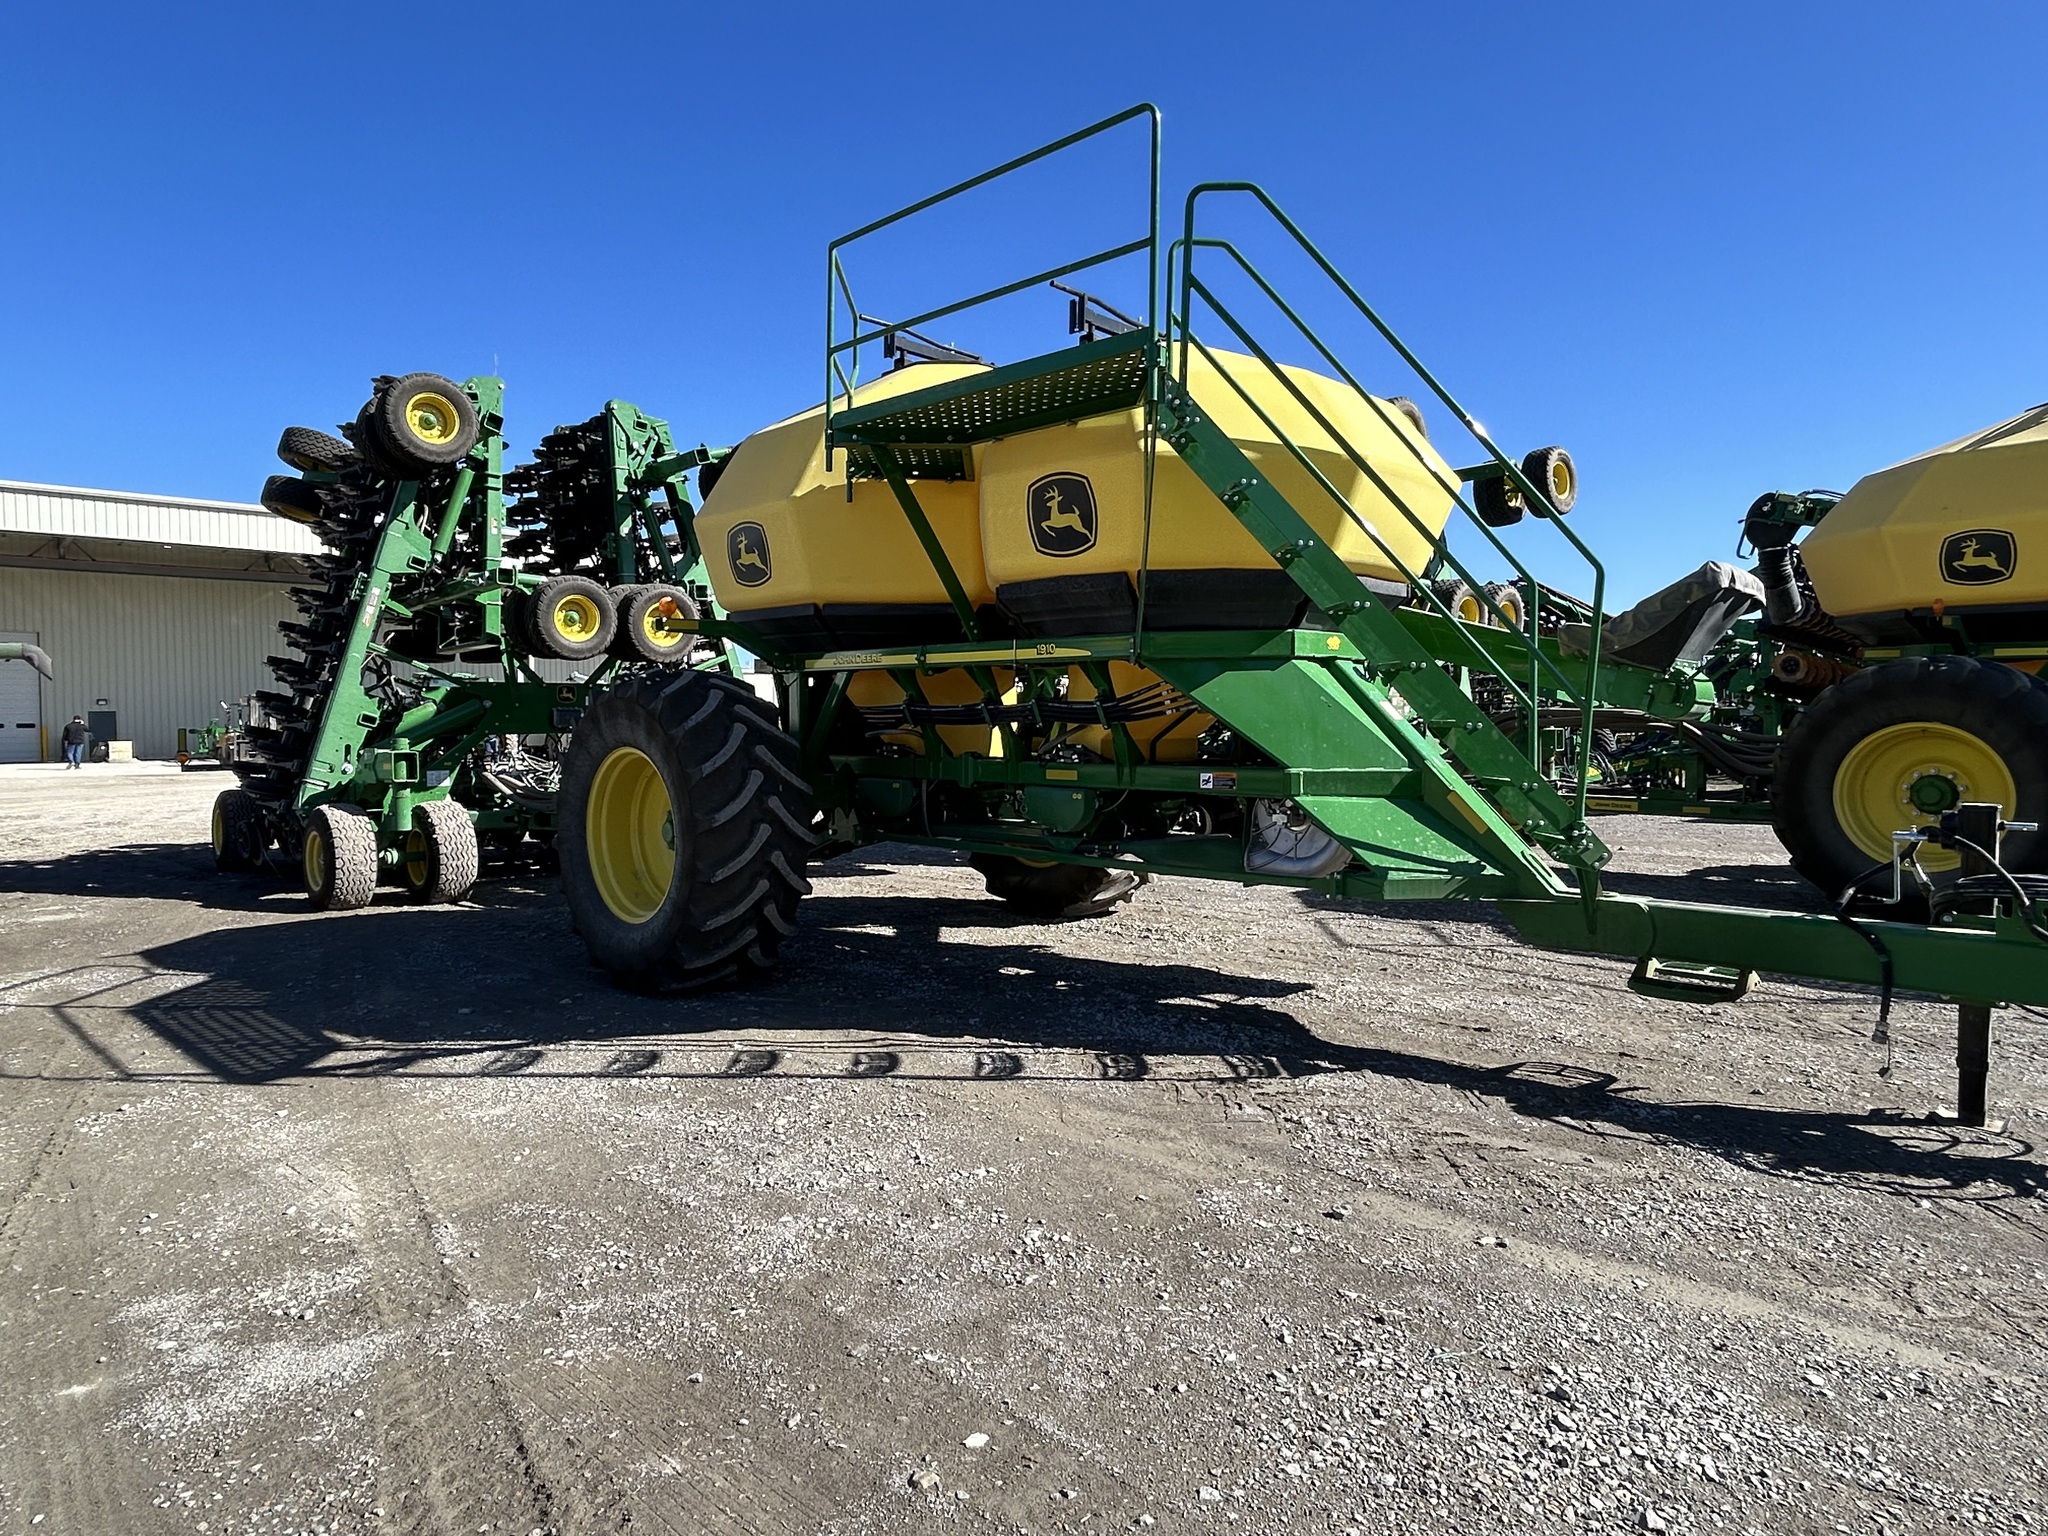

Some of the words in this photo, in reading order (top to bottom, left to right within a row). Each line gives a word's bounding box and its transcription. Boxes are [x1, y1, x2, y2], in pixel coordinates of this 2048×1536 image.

[1036, 643, 1056, 656] 1910
[833, 655, 855, 665] JOHN
[855, 653, 882, 664] DEERE
